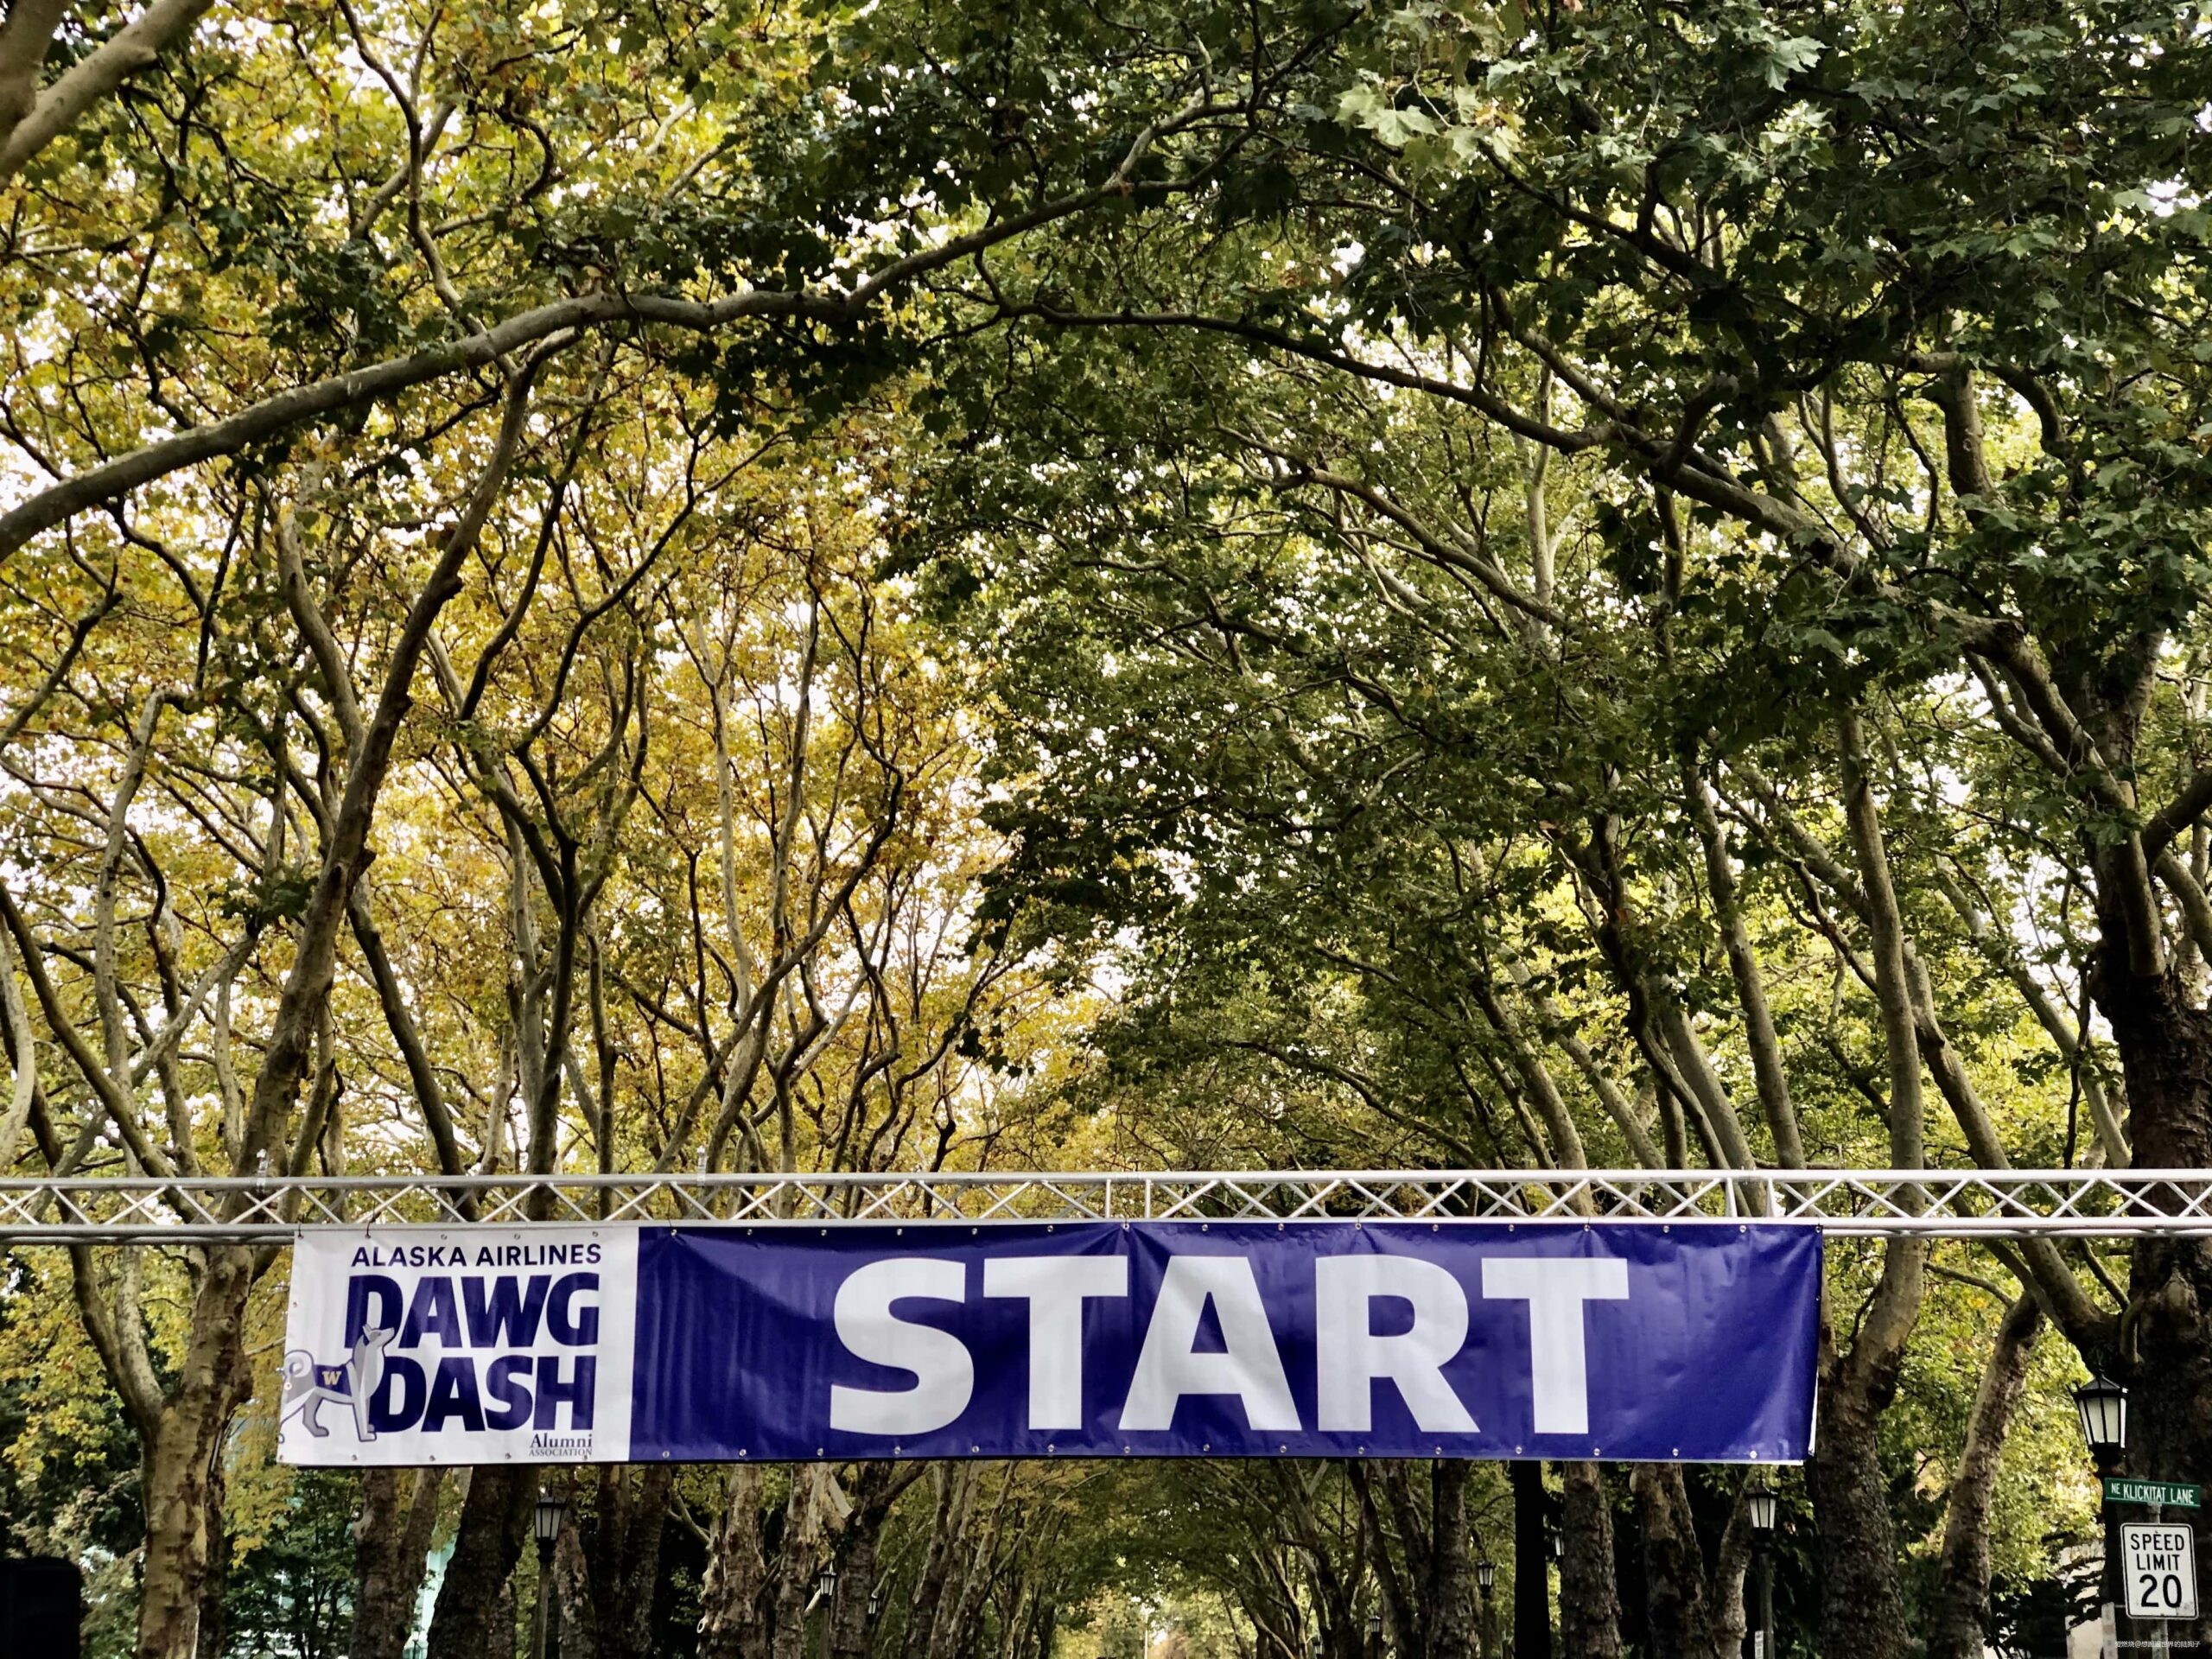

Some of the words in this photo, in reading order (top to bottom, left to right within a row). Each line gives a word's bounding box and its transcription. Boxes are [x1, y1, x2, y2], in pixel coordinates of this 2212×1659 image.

[351, 1245, 467, 1268] ALASKA
[476, 1243, 602, 1268] AIRLINES
[344, 1272, 600, 1349] DAWG
[830, 1253, 1630, 1436] START
[321, 1370, 342, 1386] W
[369, 1355, 597, 1433] DASH
[530, 1433, 593, 1448] Alumni
[529, 1448, 593, 1457] ASSOCIATION
[2111, 1483, 2121, 1495] NE
[2123, 1484, 2167, 1503] KLICKITAT
[2171, 1488, 2195, 1504] LANE
[2130, 1533, 2185, 1551] SPEED
[2136, 1554, 2181, 1571] LIMIT
[2139, 1573, 2183, 1608] 20
